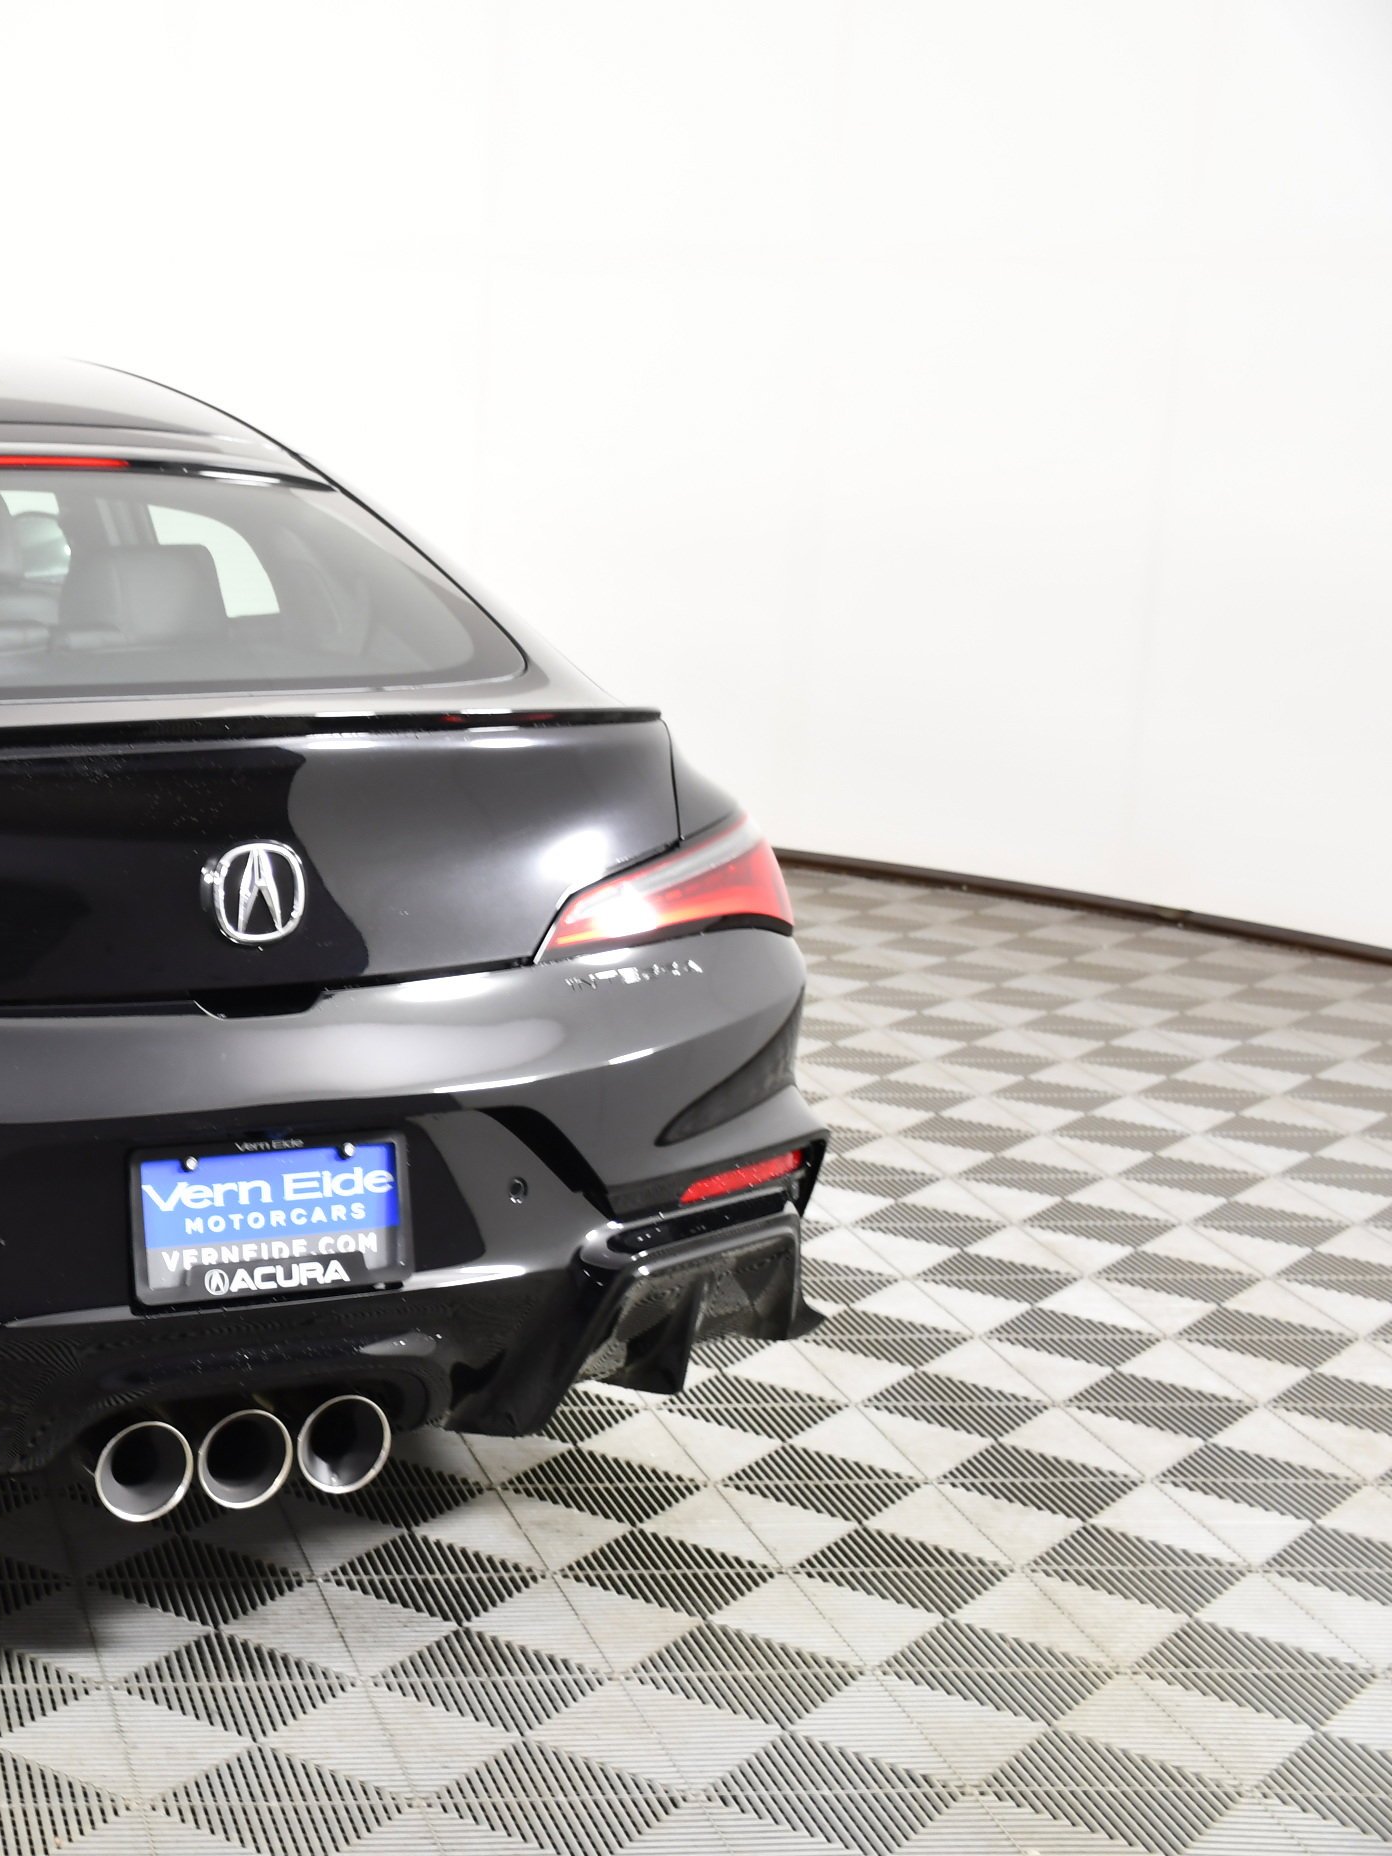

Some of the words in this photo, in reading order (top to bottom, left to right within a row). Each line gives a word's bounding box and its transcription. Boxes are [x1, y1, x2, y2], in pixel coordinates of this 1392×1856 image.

[235, 1140, 271, 1152] Vern
[272, 1137, 305, 1150] Eide
[142, 1180, 273, 1212] Vern
[281, 1166, 395, 1201] Eide
[185, 1202, 367, 1235] MOTORCARS
[229, 1259, 351, 1293] ACURA
